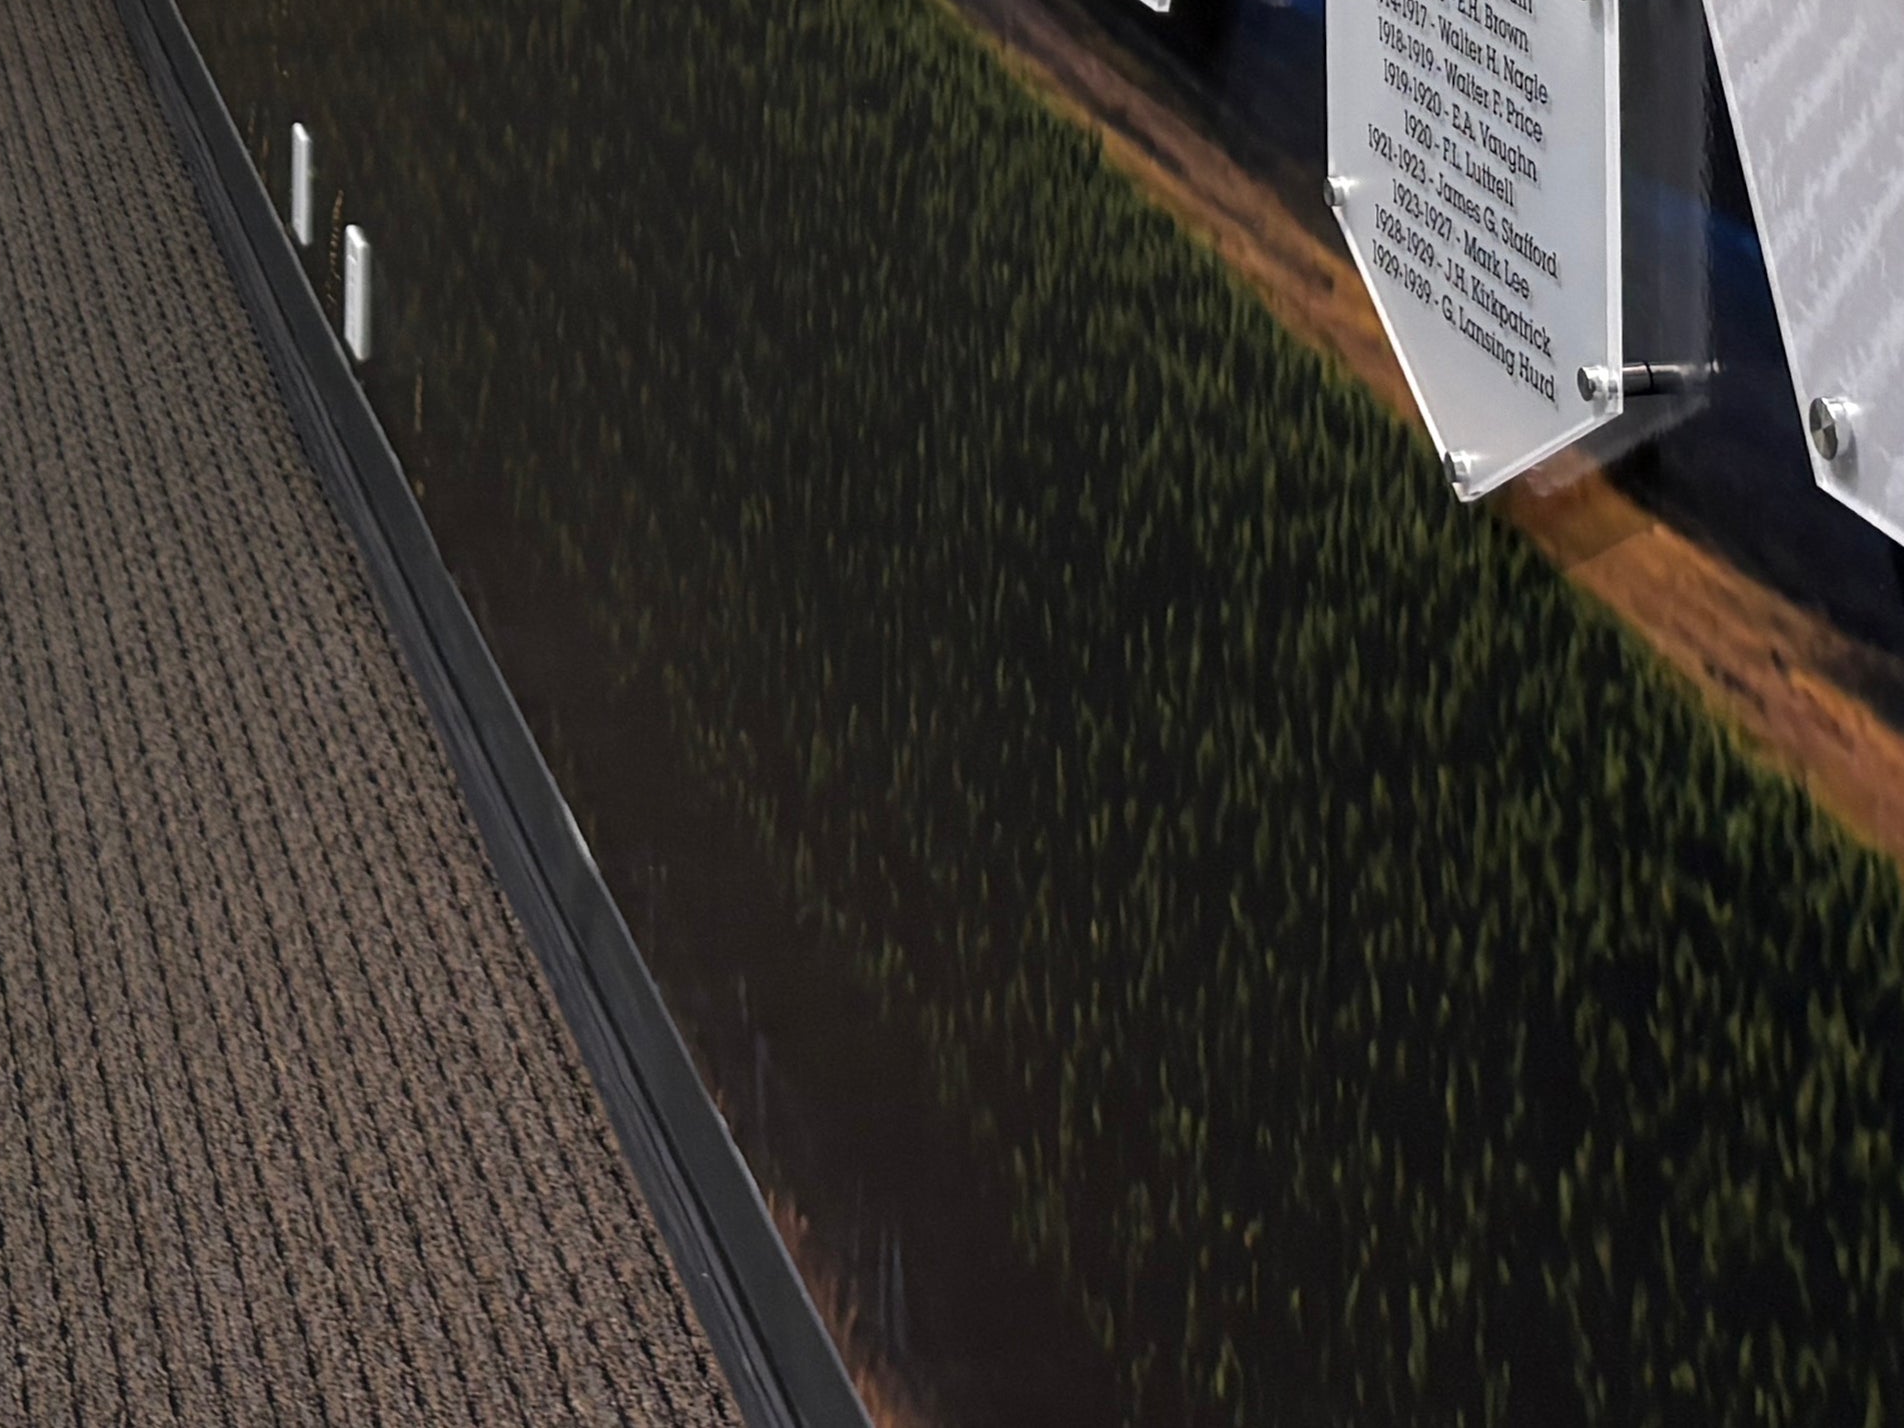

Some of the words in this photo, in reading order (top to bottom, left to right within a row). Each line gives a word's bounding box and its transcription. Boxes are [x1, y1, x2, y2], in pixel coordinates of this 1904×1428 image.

[1438, 13, 1481, 65] Walter
[1503, 52, 1548, 106] Nagle
[1484, 1, 1528, 52] Brown
[1383, 57, 1441, 119] 1919-1920
[1479, 119, 1536, 183] Vaughn
[1444, 57, 1487, 109] Walter
[1506, 95, 1542, 144] Price
[1368, 121, 1425, 186] 1921-1923
[1435, 169, 1480, 225] James
[1501, 215, 1557, 281] Stafford
[1404, 109, 1431, 152] 1920
[1465, 150, 1513, 208] Luttrell
[1392, 177, 1452, 245] 1923-1927
[1463, 228, 1500, 281] Mark
[1504, 258, 1529, 302] Lee
[1459, 305, 1515, 380] Lansing
[1518, 350, 1555, 405] Hurd
[1470, 274, 1551, 360] Kirkpatrick
